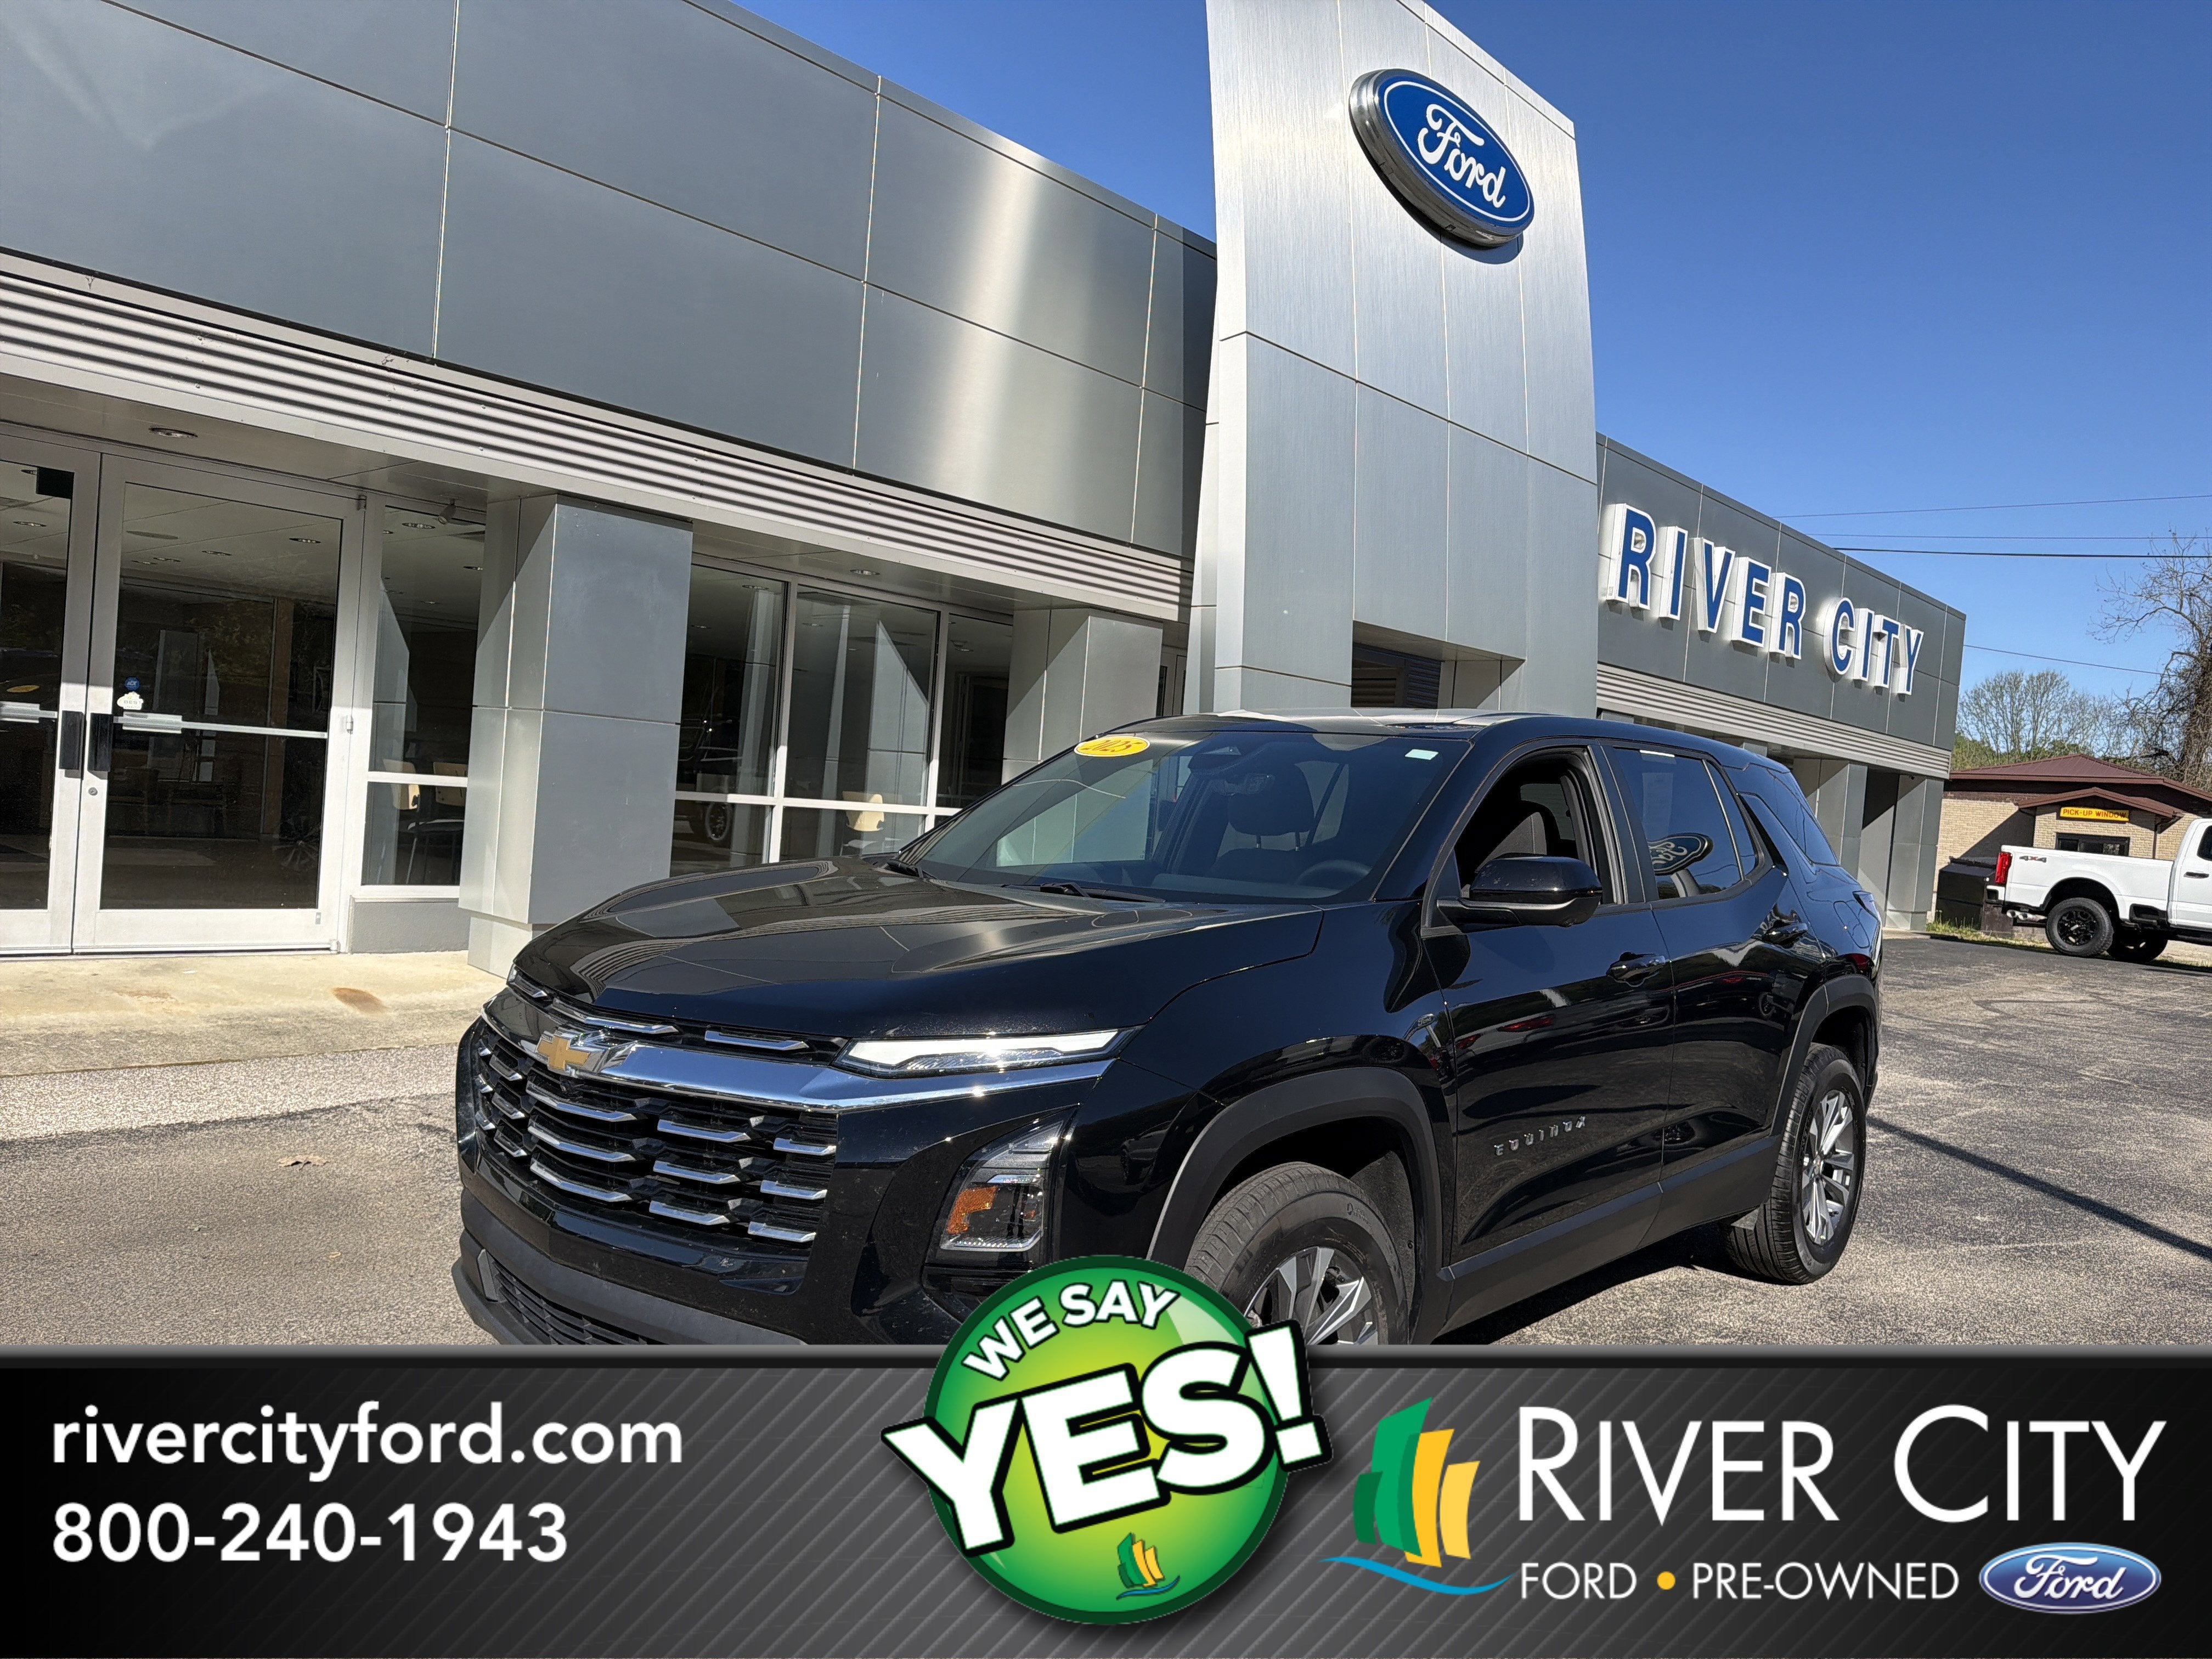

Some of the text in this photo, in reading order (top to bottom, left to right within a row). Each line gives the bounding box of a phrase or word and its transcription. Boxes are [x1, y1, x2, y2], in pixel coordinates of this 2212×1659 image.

[1418, 104, 1506, 208] Ford
[1606, 503, 1924, 696] RIVER CITY
[1080, 740, 1143, 752] 2025
[2095, 810, 2126, 819] WINDOW
[1494, 1116, 1586, 1156] EQUINOX
